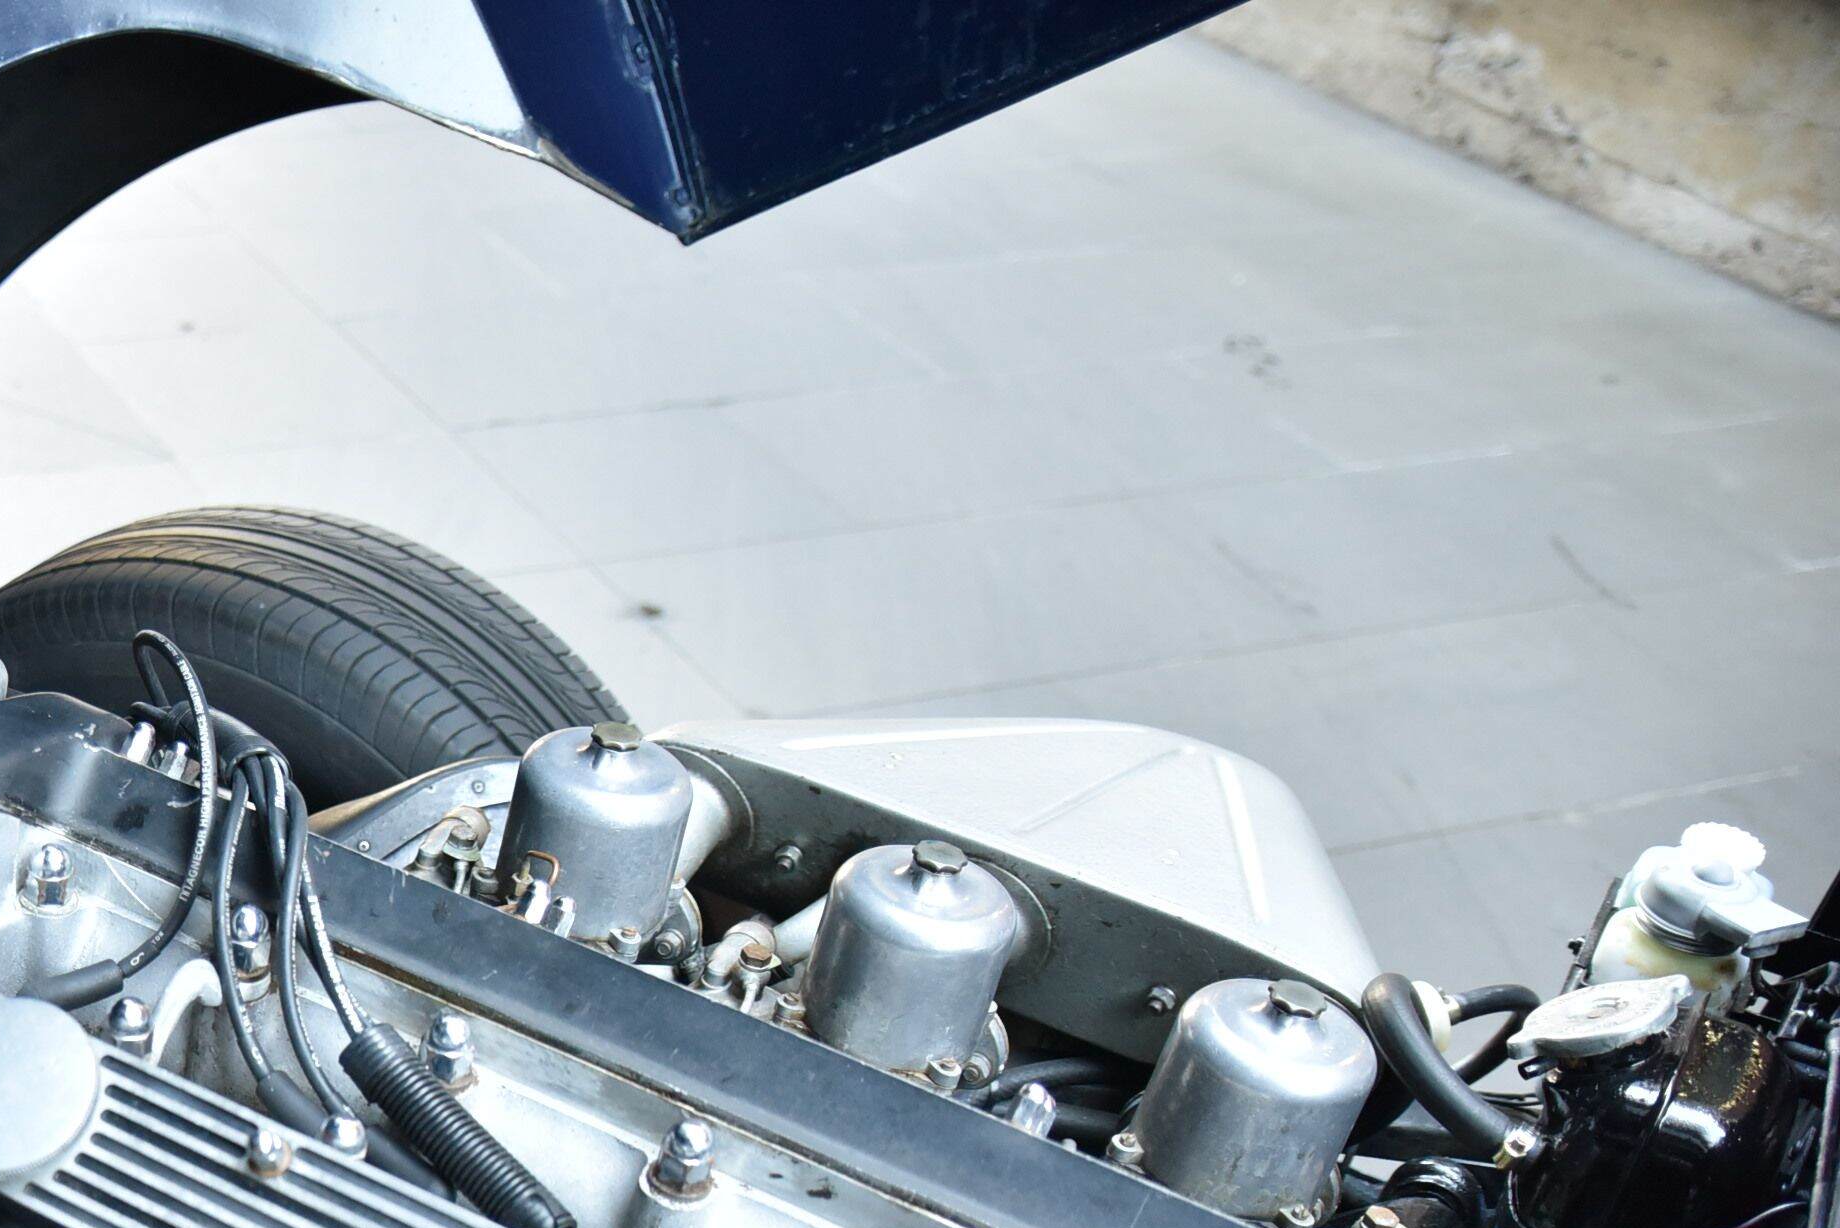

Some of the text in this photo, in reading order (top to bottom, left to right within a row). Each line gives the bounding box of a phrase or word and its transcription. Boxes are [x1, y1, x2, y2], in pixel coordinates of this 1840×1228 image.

[177, 659, 213, 902] MAGNECOR HIGH PERFORMANCE IGNITION CABLE
